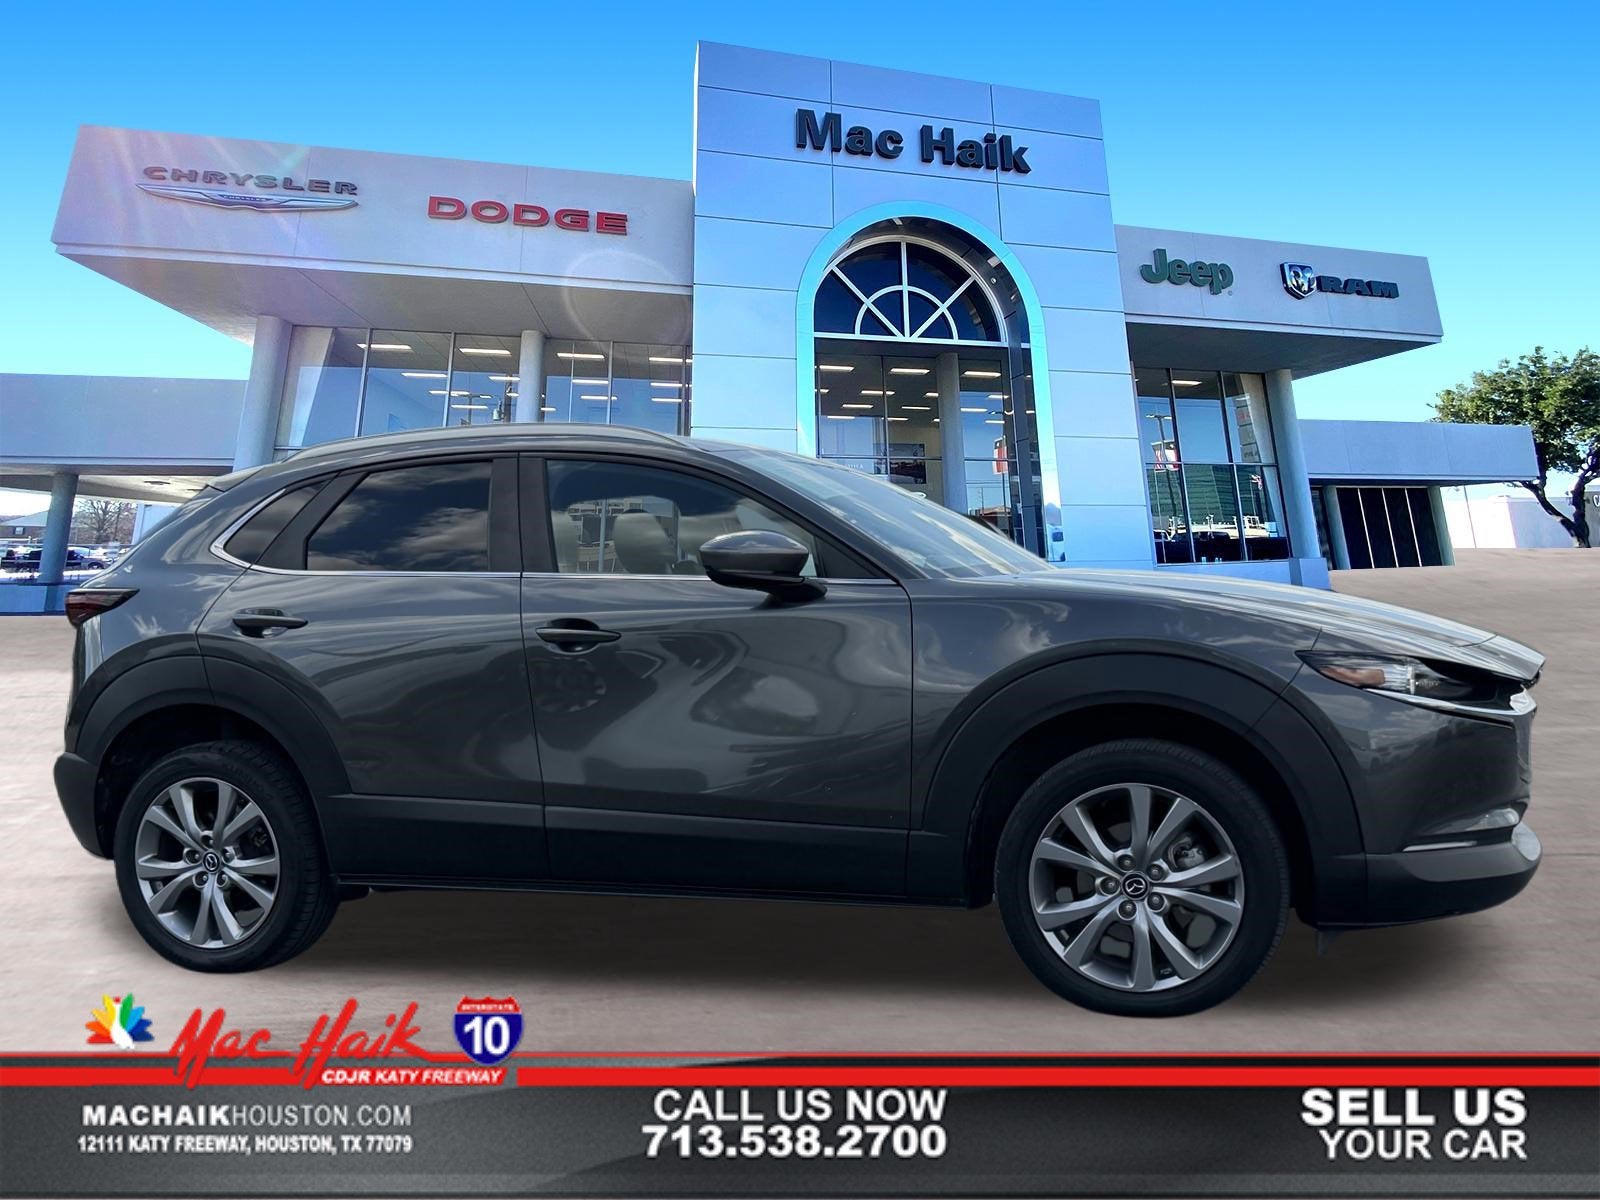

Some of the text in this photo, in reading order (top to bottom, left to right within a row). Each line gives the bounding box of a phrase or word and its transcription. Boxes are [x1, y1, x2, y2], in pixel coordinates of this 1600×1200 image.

[796, 108, 1032, 174] Mac Haik
[143, 166, 358, 195] CHRYSLER
[428, 195, 628, 236] DODGE
[1140, 249, 1234, 295] Jeep
[1315, 275, 1400, 299] RAM
